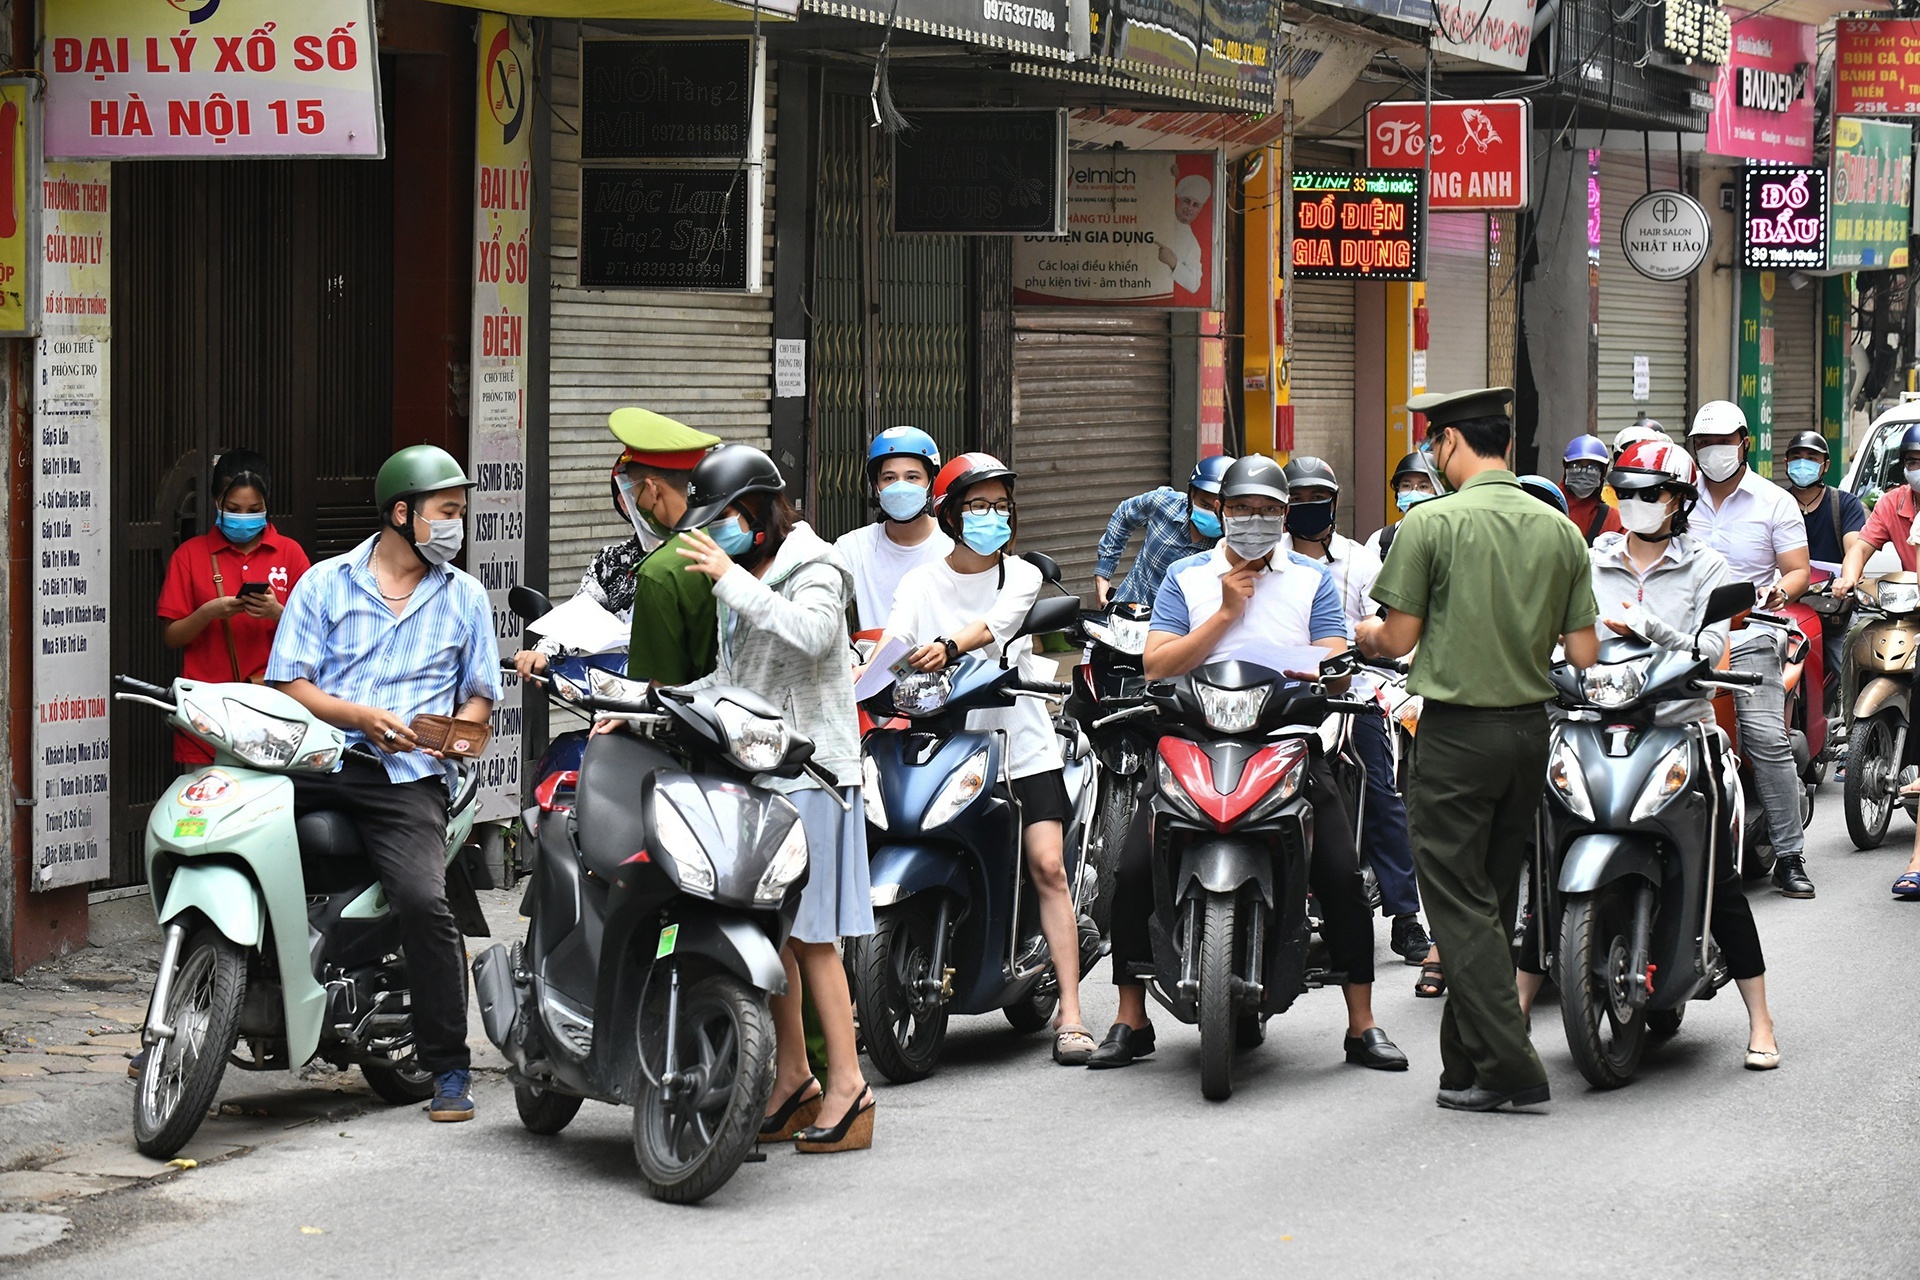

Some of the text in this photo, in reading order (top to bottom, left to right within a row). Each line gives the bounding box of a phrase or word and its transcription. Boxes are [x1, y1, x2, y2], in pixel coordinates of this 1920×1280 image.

[984, 0, 1055, 31] 0975337584
[1846, 21, 1880, 33] 39A
[52, 21, 357, 81] ĐẠI LÝ XỔ SỐ
[726, 81, 738, 101] 2
[89, 92, 326, 145] HÀ NỘI 15
[1853, 101, 1888, 113] 25K
[1376, 118, 1446, 156] Tóc
[920, 146, 989, 179] HAIR
[82, 178, 107, 213] THÊM
[480, 161, 529, 219] ĐẠI LÝ
[668, 182, 731, 214] Lan
[1315, 177, 1350, 189] LINH
[1353, 177, 1366, 192] 33
[1468, 171, 1512, 198] ANH
[911, 185, 1003, 219] LOUIS
[1298, 193, 1404, 236] ĐỒ ĐIỆN
[1097, 212, 1137, 224] TÚ LINH
[1639, 228, 1691, 236] HAIR SALON
[46, 225, 103, 271] CỦA ĐẠI LÝ
[649, 228, 662, 248] 2
[670, 219, 732, 259] Spa
[1084, 231, 1110, 244] GIA
[1112, 231, 1154, 247] DỤNG
[1630, 239, 1701, 255] NHẬT HÀO
[478, 224, 528, 284] XỔ SỐ
[1038, 259, 1057, 271] Các
[1060, 260, 1079, 273] loại
[1292, 239, 1411, 272] GIA DỤNG
[1751, 247, 1768, 261] 39
[1025, 277, 1151, 290] phụ kiện tivi âm thanh
[54, 341, 72, 354] CHO
[482, 306, 522, 367] ĐIỆN
[51, 361, 97, 378] PHÒNG TRỌ
[484, 372, 498, 383] CHO
[1760, 374, 1772, 395] CÁ
[1760, 400, 1772, 425] ỐC
[1760, 429, 1772, 451] BÒ
[476, 462, 502, 492] XSMB
[53, 521, 61, 538] 10
[475, 511, 523, 541] XSĐT 1-2-3
[504, 554, 518, 589] TÀI
[500, 610, 506, 638] 2
[48, 694, 58, 722] XỔ
[60, 693, 69, 721] SỐ
[70, 695, 87, 724] ĐIỆN
[88, 694, 106, 718] TOÁN
[502, 707, 521, 741] CHỌN
[487, 746, 519, 793] CẶP SỐ
[64, 810, 68, 829] 2
